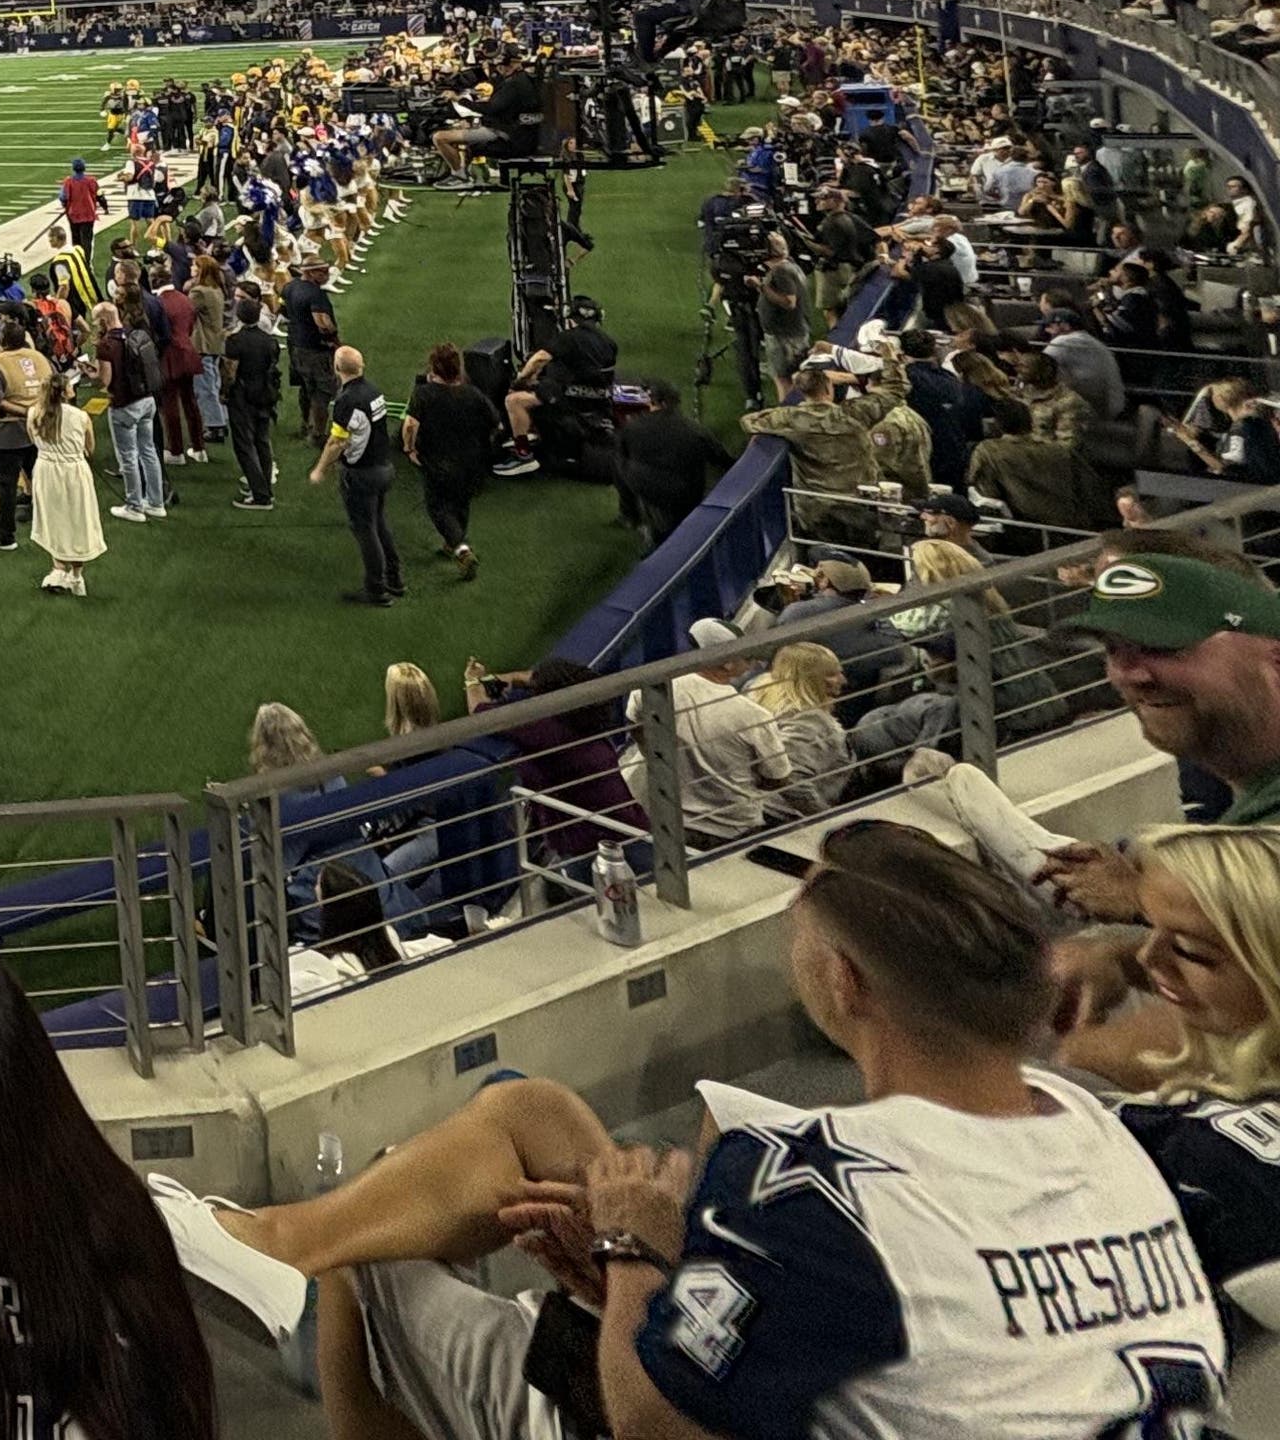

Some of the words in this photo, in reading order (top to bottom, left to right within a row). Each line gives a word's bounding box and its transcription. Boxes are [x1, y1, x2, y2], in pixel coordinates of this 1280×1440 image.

[1093, 561, 1163, 600] G
[672, 1262, 759, 1382] 4
[976, 1220, 1207, 1339] PRESCOTT
